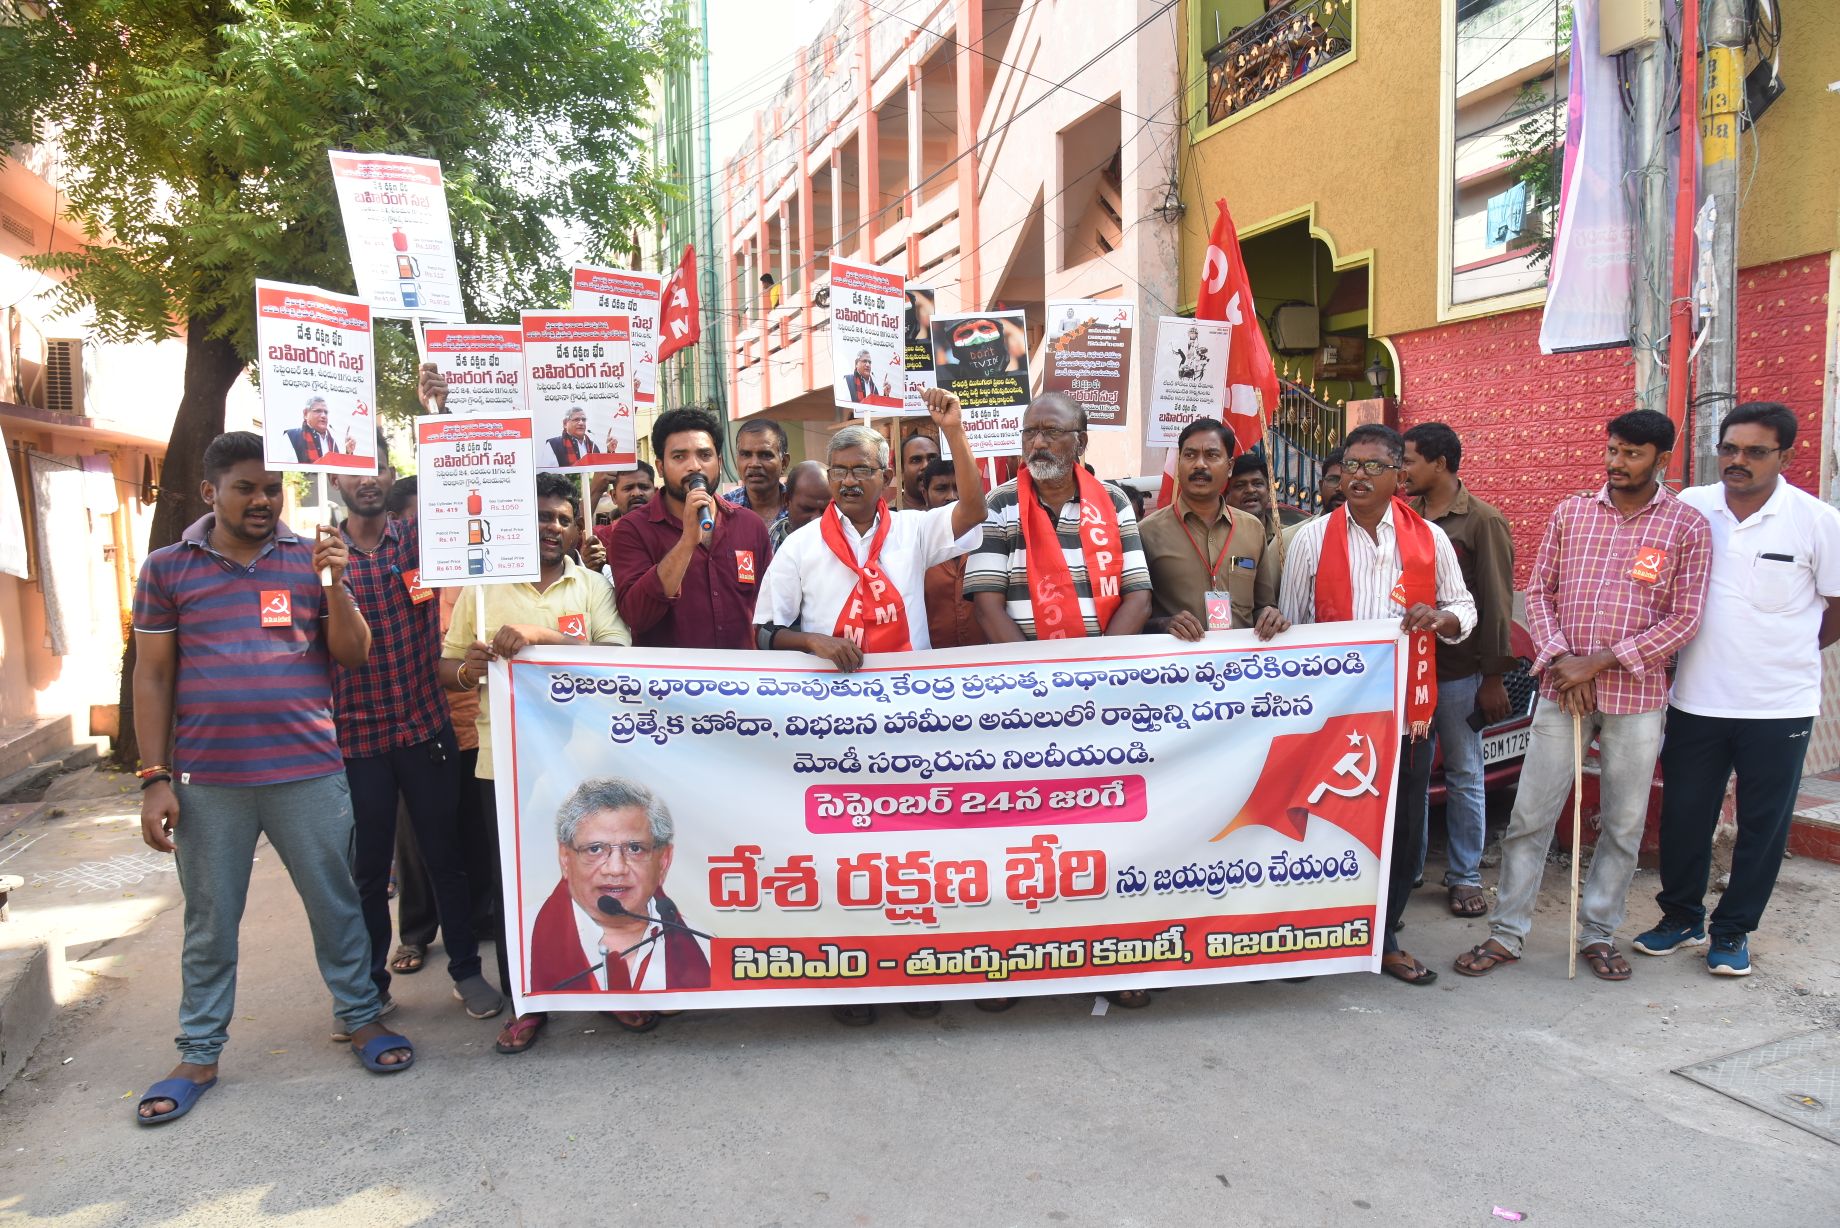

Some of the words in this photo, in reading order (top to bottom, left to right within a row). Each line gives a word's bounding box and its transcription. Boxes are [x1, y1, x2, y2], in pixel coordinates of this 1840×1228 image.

[599, 295, 609, 308] దేశ
[852, 291, 862, 305] దేశ
[632, 316, 653, 331] సభ
[835, 307, 879, 327] బహిరంగ
[881, 314, 900, 332] సభ
[297, 323, 311, 340] దేశ
[315, 328, 330, 347] రక్షణ
[268, 344, 336, 367] బహిరంగ
[339, 352, 364, 373] సభ
[456, 353, 467, 367] దేశ
[470, 355, 486, 370] రక్షణ
[556, 343, 570, 359] దేశ
[573, 345, 590, 362] రక్షణ
[496, 371, 519, 387] సభ
[532, 362, 597, 379] బహిరంగ
[600, 361, 625, 380] సభ
[1001, 416, 1019, 430] సభ
[1159, 413, 1194, 424] బహిరంగ
[455, 443, 466, 453] దేశ
[433, 452, 490, 468] బహిరంగ
[493, 451, 516, 467] సభ
[1089, 528, 1119, 597] CPM
[550, 672, 643, 703] ప్రజలపై
[647, 674, 751, 702] భారాలు
[756, 677, 891, 703] మోపుతున్న
[891, 673, 956, 701] కేంద్ర
[961, 671, 1049, 698] ప్రభుత్వ
[1051, 662, 1190, 693] విధానాలను
[1195, 652, 1366, 693] వ్యతిరేకించండి
[1414, 635, 1429, 706] CPM
[610, 709, 685, 746] ప్రత్యేక
[691, 710, 780, 739] హోదా,
[785, 710, 878, 738] విభజన
[884, 706, 973, 736] హామీల
[978, 701, 1097, 732] అమలులో
[1101, 703, 1191, 732] రాష్ట్రాన్ని
[1191, 700, 1246, 723] దగా
[1250, 691, 1314, 718] చేసిన
[792, 746, 863, 775] మోడీ
[868, 749, 996, 780] సర్కారును
[1002, 742, 1156, 771] నిలదీయండి.
[813, 787, 954, 828] సెప్టెంబర్
[960, 787, 1043, 814] 24న
[1048, 781, 1126, 811] జరిగే
[707, 844, 821, 910] దేశ
[836, 850, 990, 926] రక్షణ
[1116, 867, 1149, 895] ను
[1153, 859, 1264, 898] జయప్రదం
[1267, 849, 1361, 883] చేయండి
[733, 944, 869, 980] సిపిఎం
[1205, 918, 1370, 959] విజయవాడ
